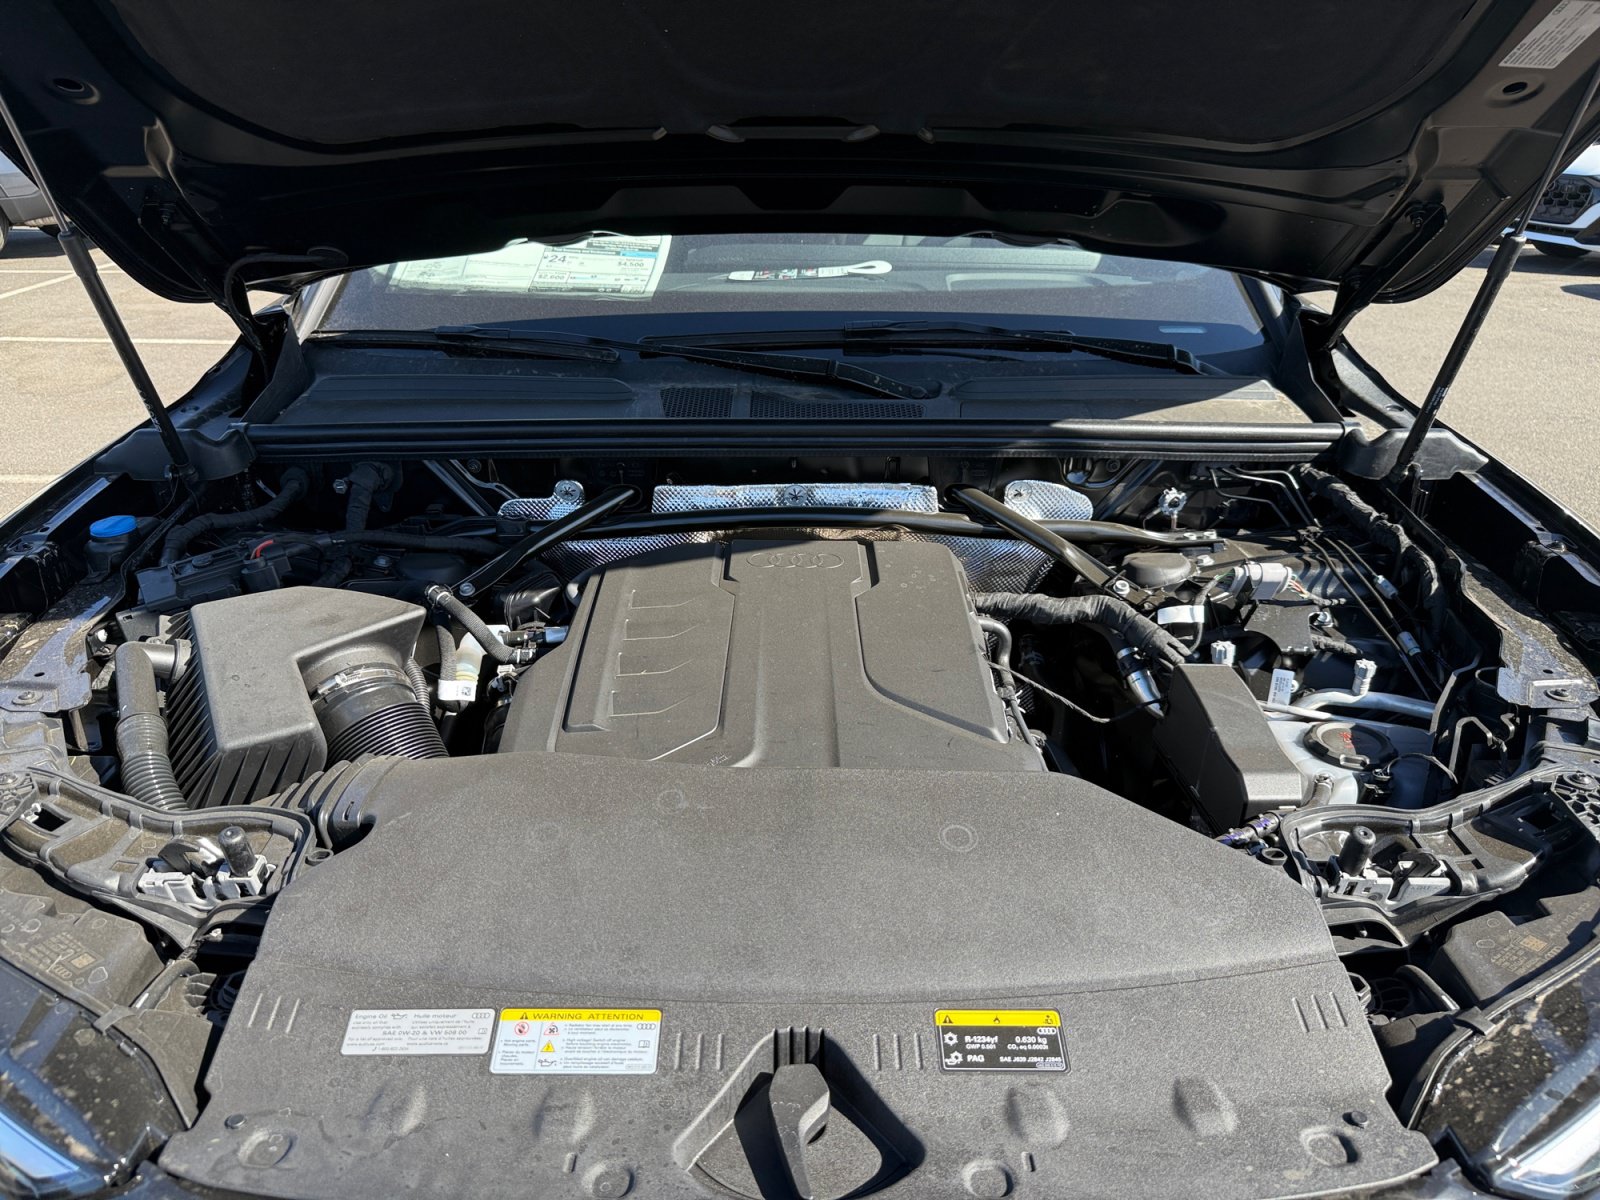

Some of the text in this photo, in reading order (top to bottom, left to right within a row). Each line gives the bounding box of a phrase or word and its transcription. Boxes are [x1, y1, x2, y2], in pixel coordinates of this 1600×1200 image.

[548, 254, 567, 263] 24
[964, 1035, 1048, 1044] R-1234yf 0.630 kg
[967, 1054, 985, 1062] PAG
